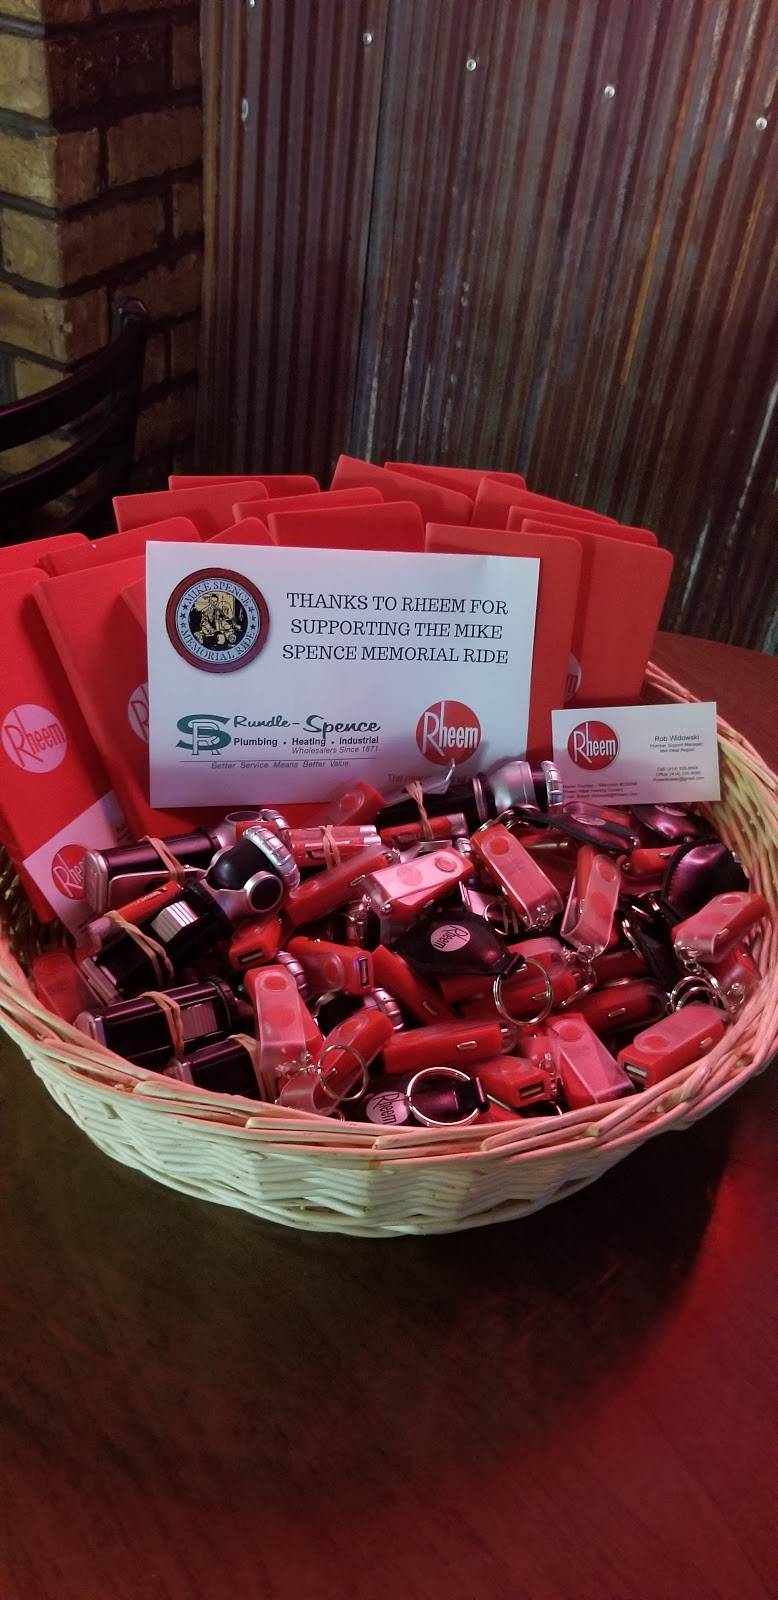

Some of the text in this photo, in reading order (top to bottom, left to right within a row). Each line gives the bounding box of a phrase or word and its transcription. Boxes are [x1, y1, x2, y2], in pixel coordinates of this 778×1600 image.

[184, 581, 250, 607] MIKE SPENCE
[286, 592, 509, 616] THANKS TO RHEEM FOR
[290, 618, 503, 640] SUPPORTING THE MIKE
[180, 629, 256, 661] MEMORIAL RIDE
[282, 644, 509, 664] SPENCE MEMORIAL RIDE
[3, 709, 65, 768] Rheem
[234, 735, 379, 747] Plumbing Heating Industrial
[423, 701, 479, 757] Rheem
[291, 746, 337, 754] Wholesalers
[339, 745, 359, 753] Since
[573, 722, 616, 764] Rheem
[211, 761, 236, 770] Better
[240, 760, 269, 769] Service
[303, 760, 326, 768] Better
[434, 925, 469, 951] Rheem
[373, 1093, 400, 1124] Rheem
